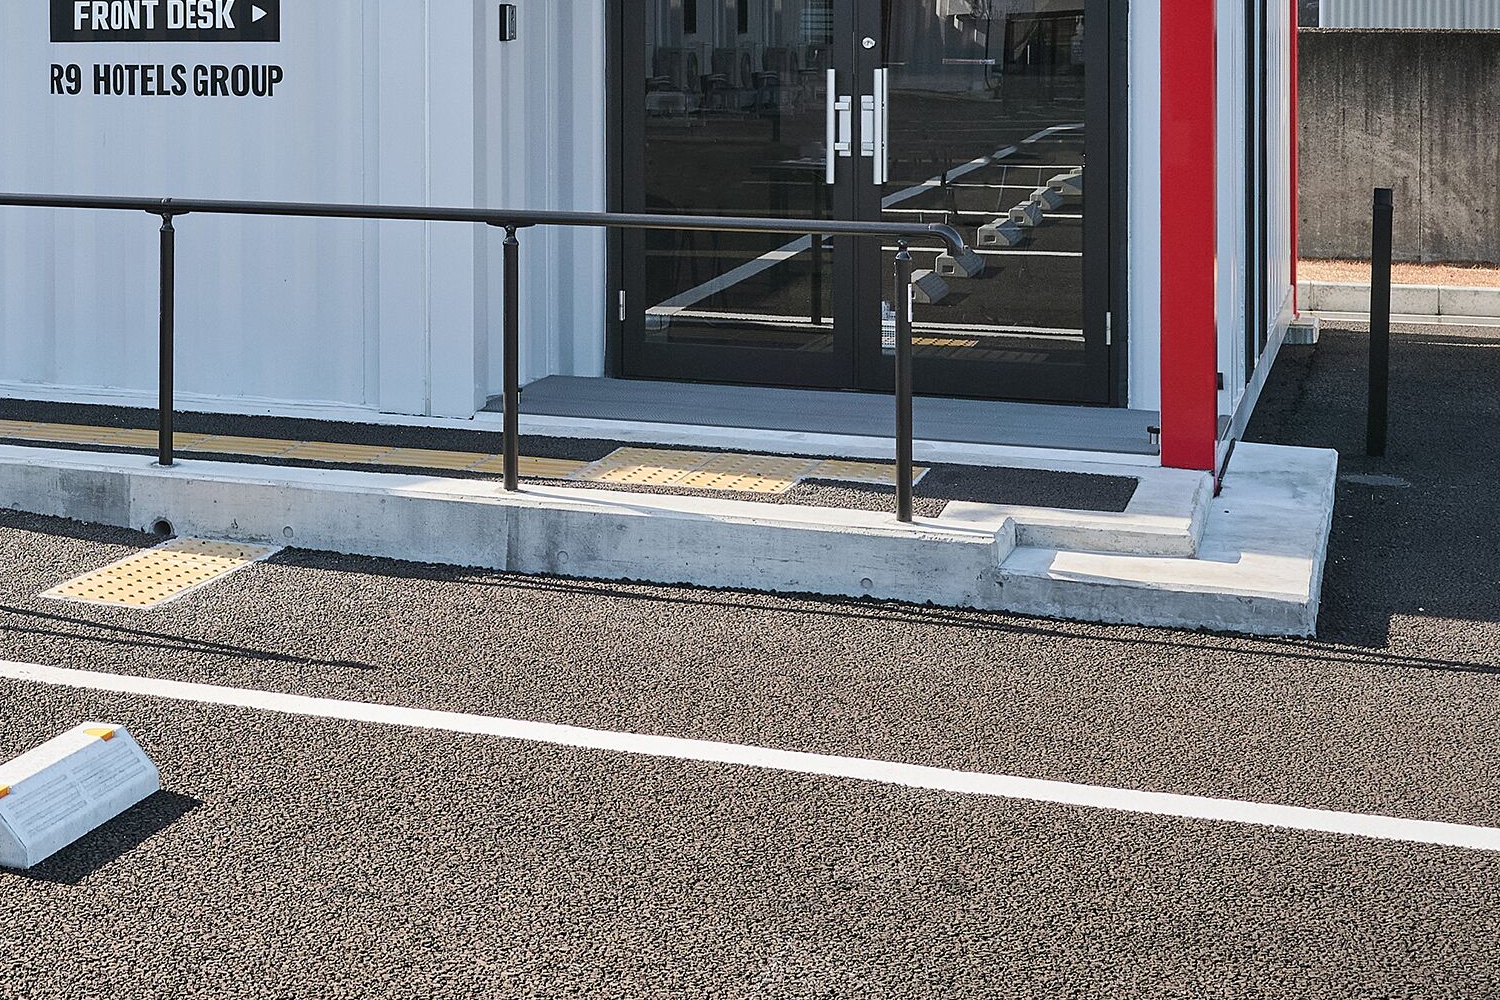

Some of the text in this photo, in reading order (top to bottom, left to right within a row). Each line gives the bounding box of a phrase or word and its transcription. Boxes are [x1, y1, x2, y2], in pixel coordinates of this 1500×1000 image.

[73, 0, 159, 31] FRONT
[50, 63, 284, 97] R9 HOTELS GROUP
